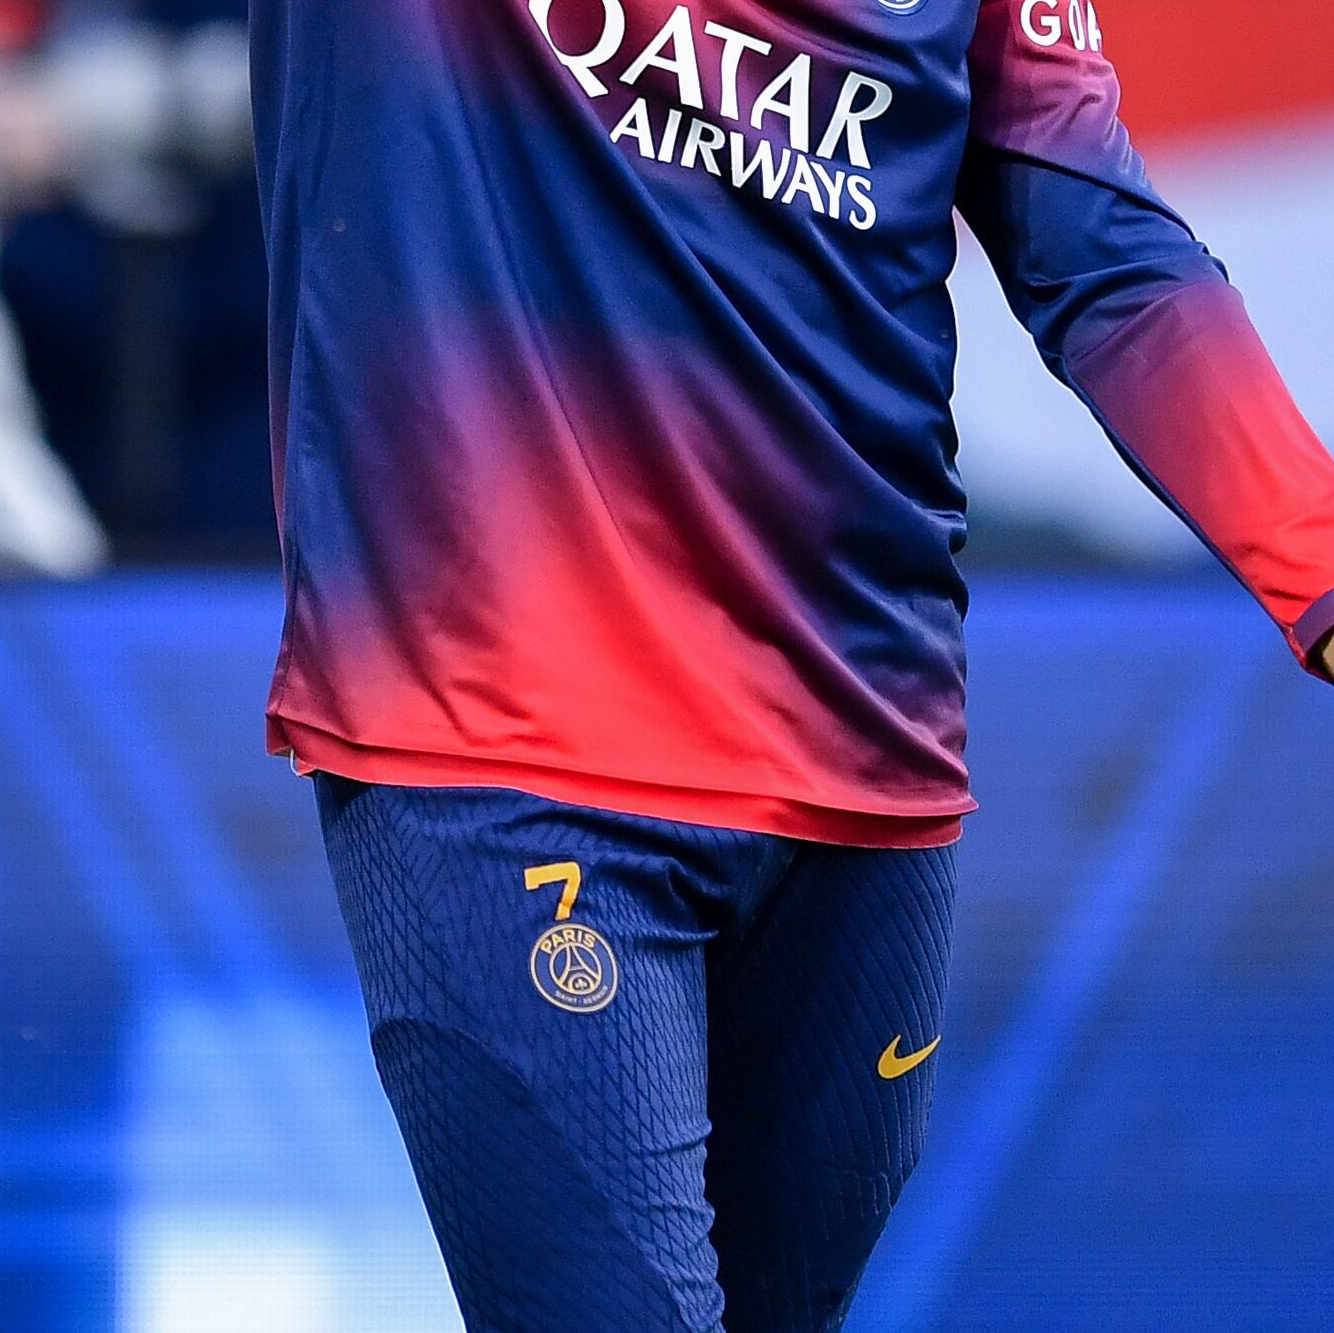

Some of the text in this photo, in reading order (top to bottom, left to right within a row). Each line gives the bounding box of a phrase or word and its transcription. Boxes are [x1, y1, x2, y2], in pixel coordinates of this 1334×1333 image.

[609, 96, 877, 231] AIRWAYS
[523, 861, 581, 921] 7
[540, 929, 596, 955] PARIS
